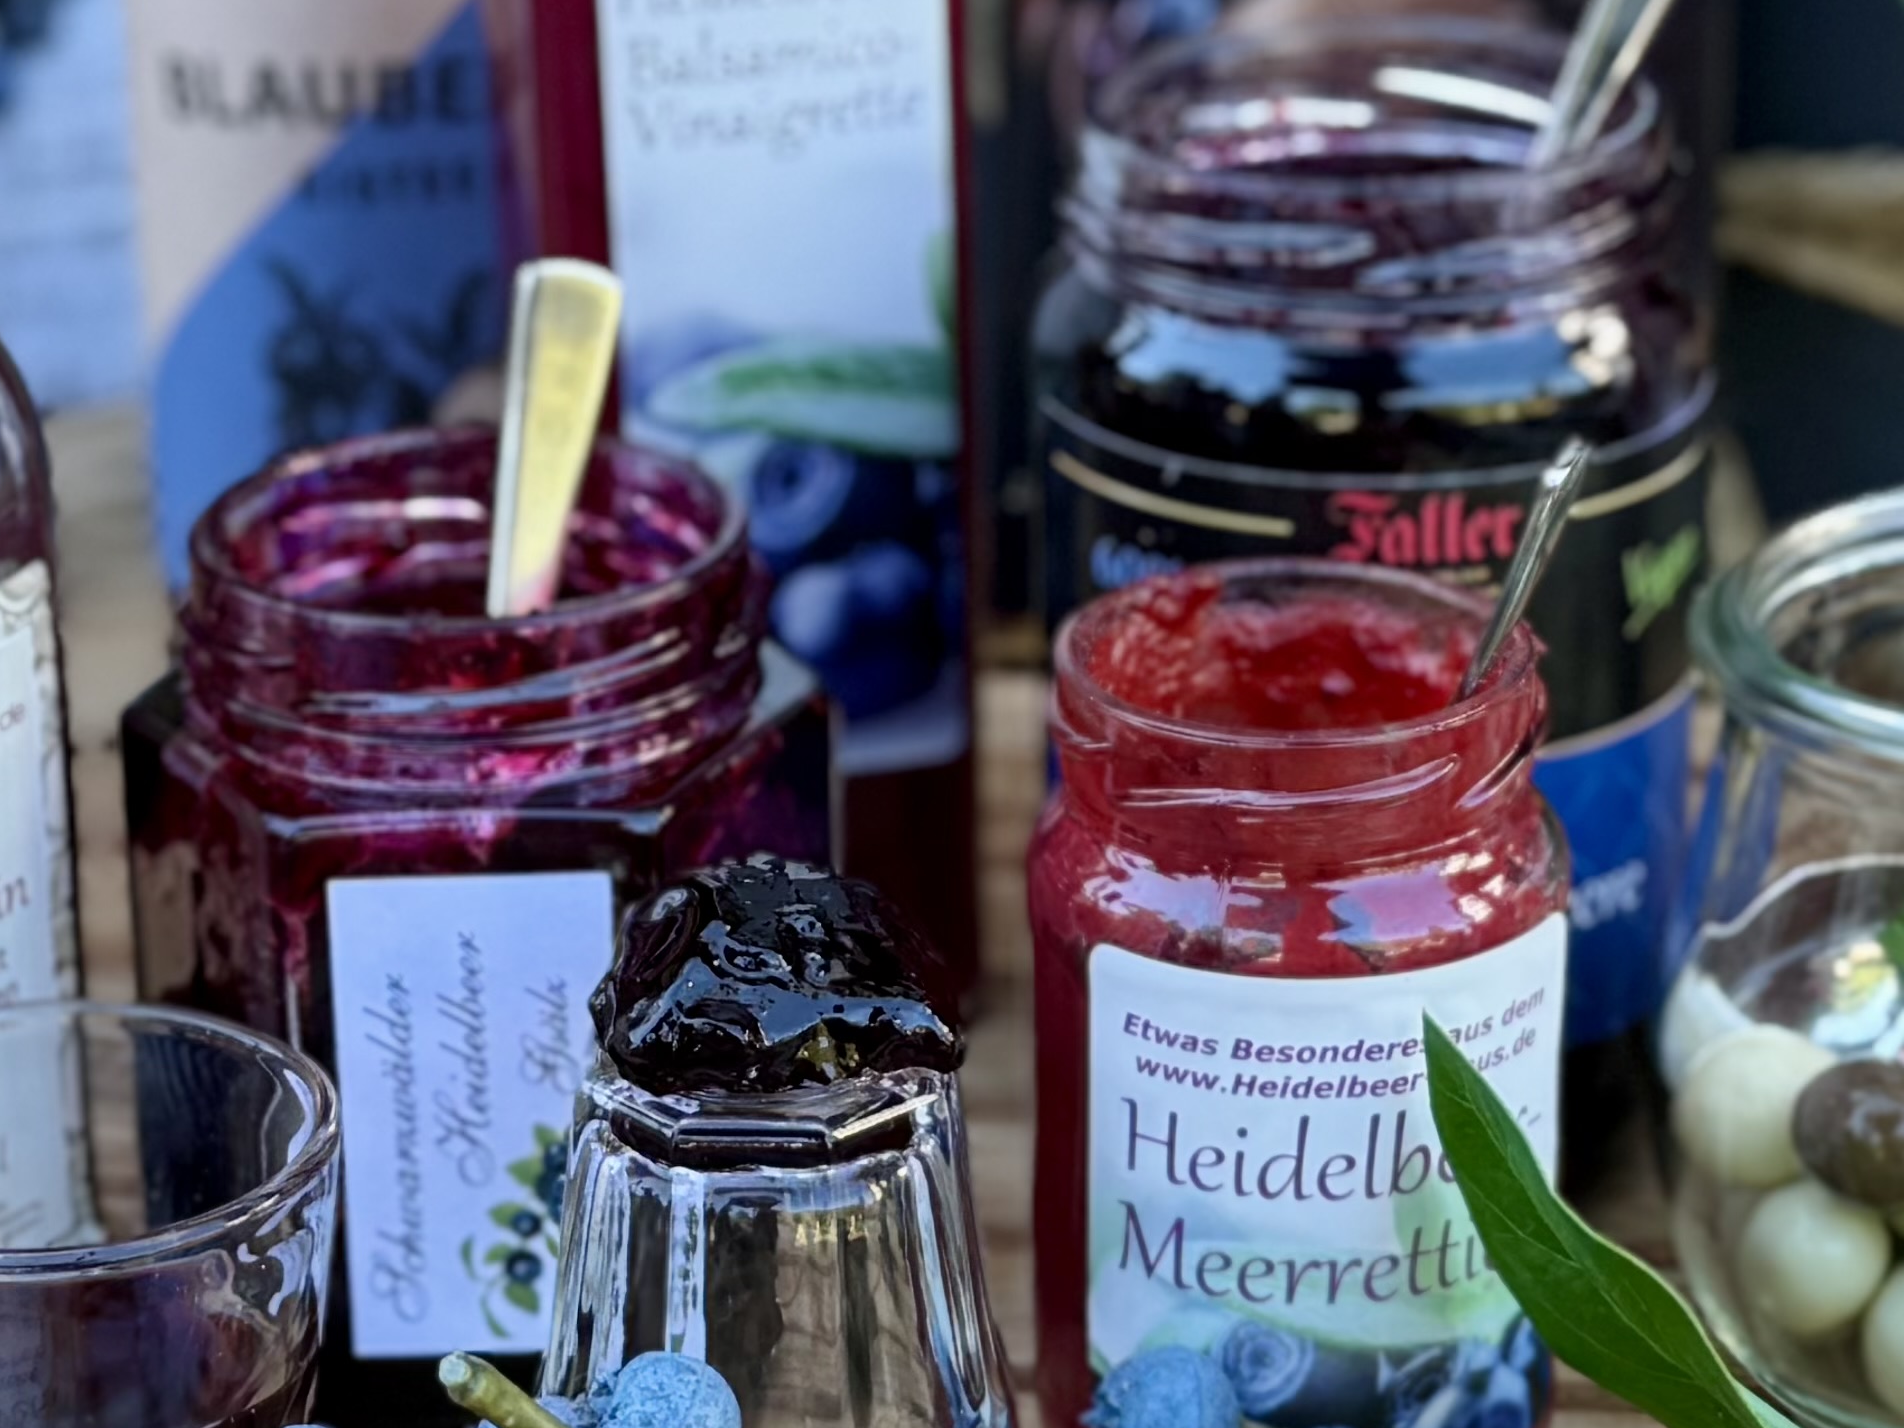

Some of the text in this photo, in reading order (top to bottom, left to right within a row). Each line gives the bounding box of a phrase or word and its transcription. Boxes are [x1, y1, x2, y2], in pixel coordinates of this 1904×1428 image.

[1122, 1012, 1220, 1056] Etwas
[1501, 986, 1545, 1027] dem
[1117, 1199, 1498, 1306] Meerretti
